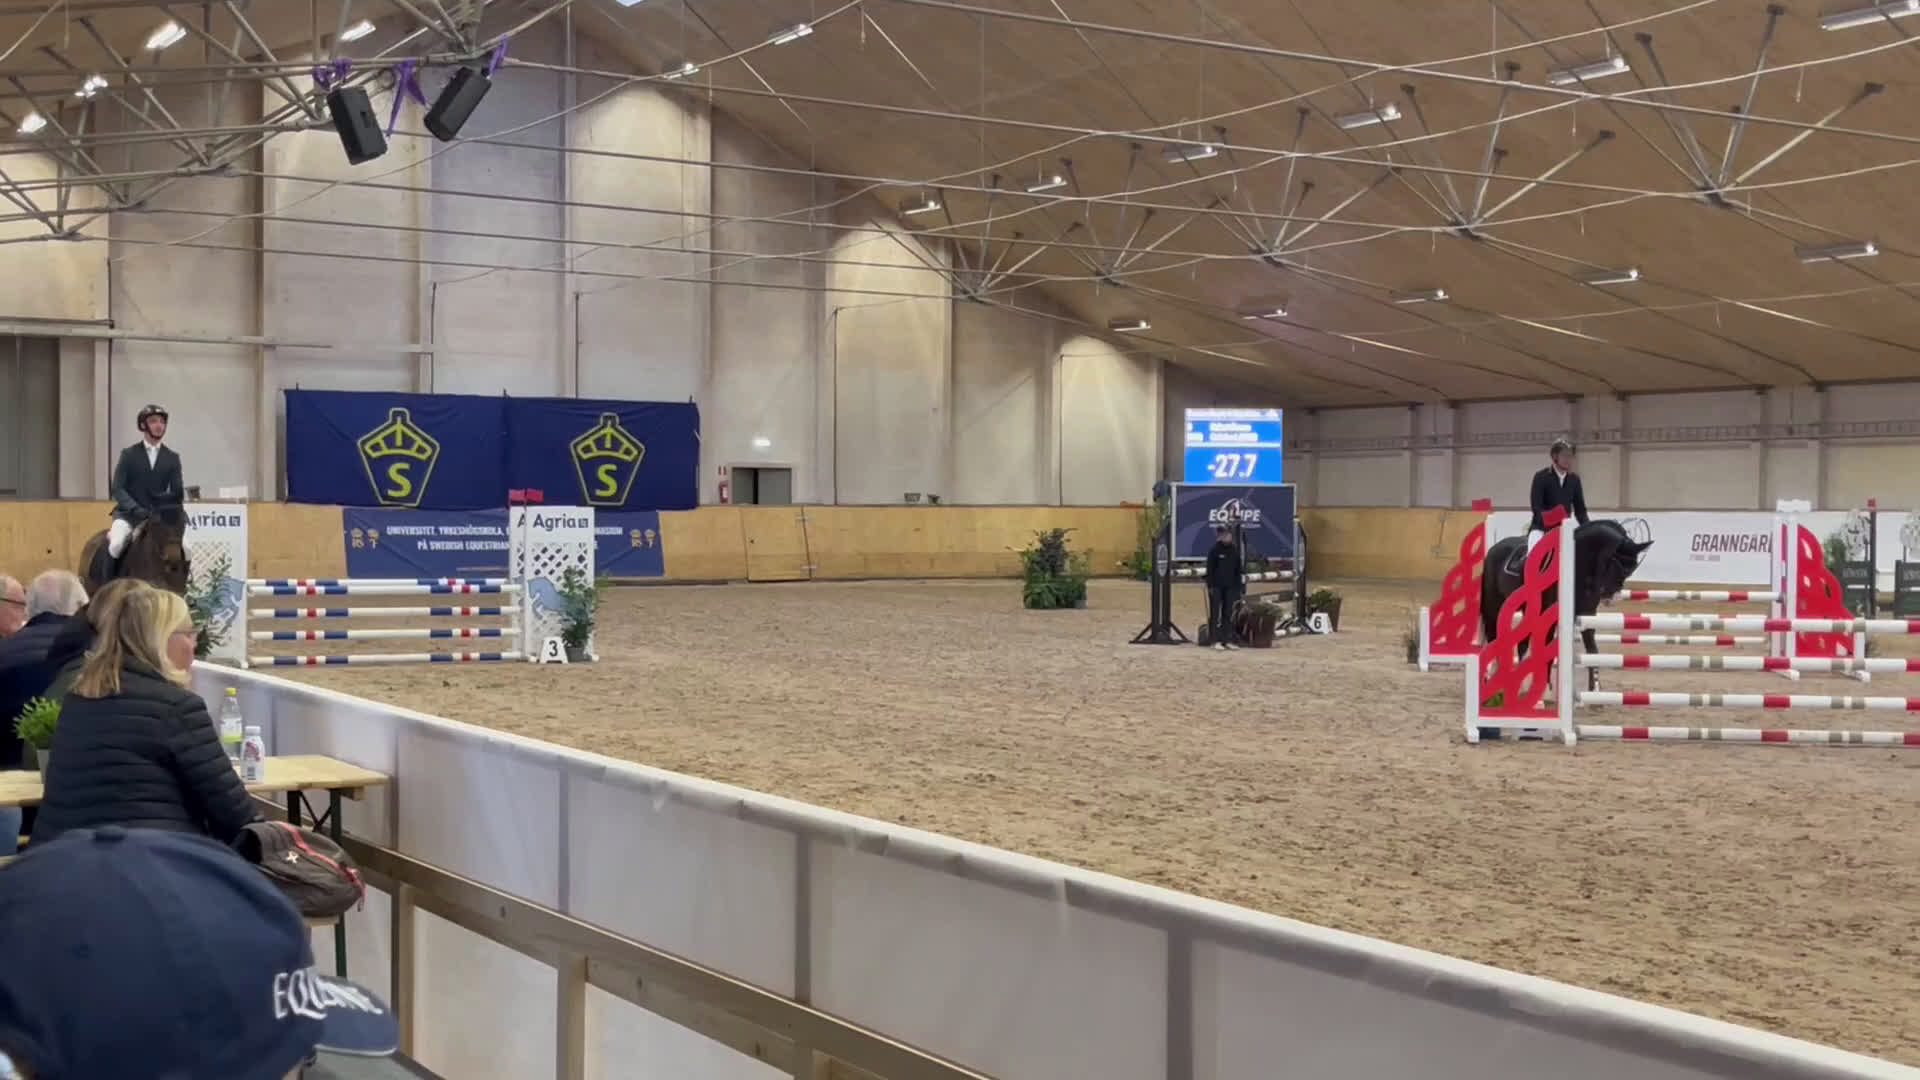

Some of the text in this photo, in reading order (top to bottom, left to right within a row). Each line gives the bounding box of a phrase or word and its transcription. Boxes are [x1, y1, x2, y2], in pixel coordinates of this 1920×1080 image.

[1207, 453, 1258, 478] -27.7
[387, 463, 412, 498] S
[595, 463, 617, 497] S
[184, 511, 227, 530] gria
[533, 513, 577, 531] Agria
[1313, 616, 1322, 630] 6
[549, 640, 558, 657] 3
